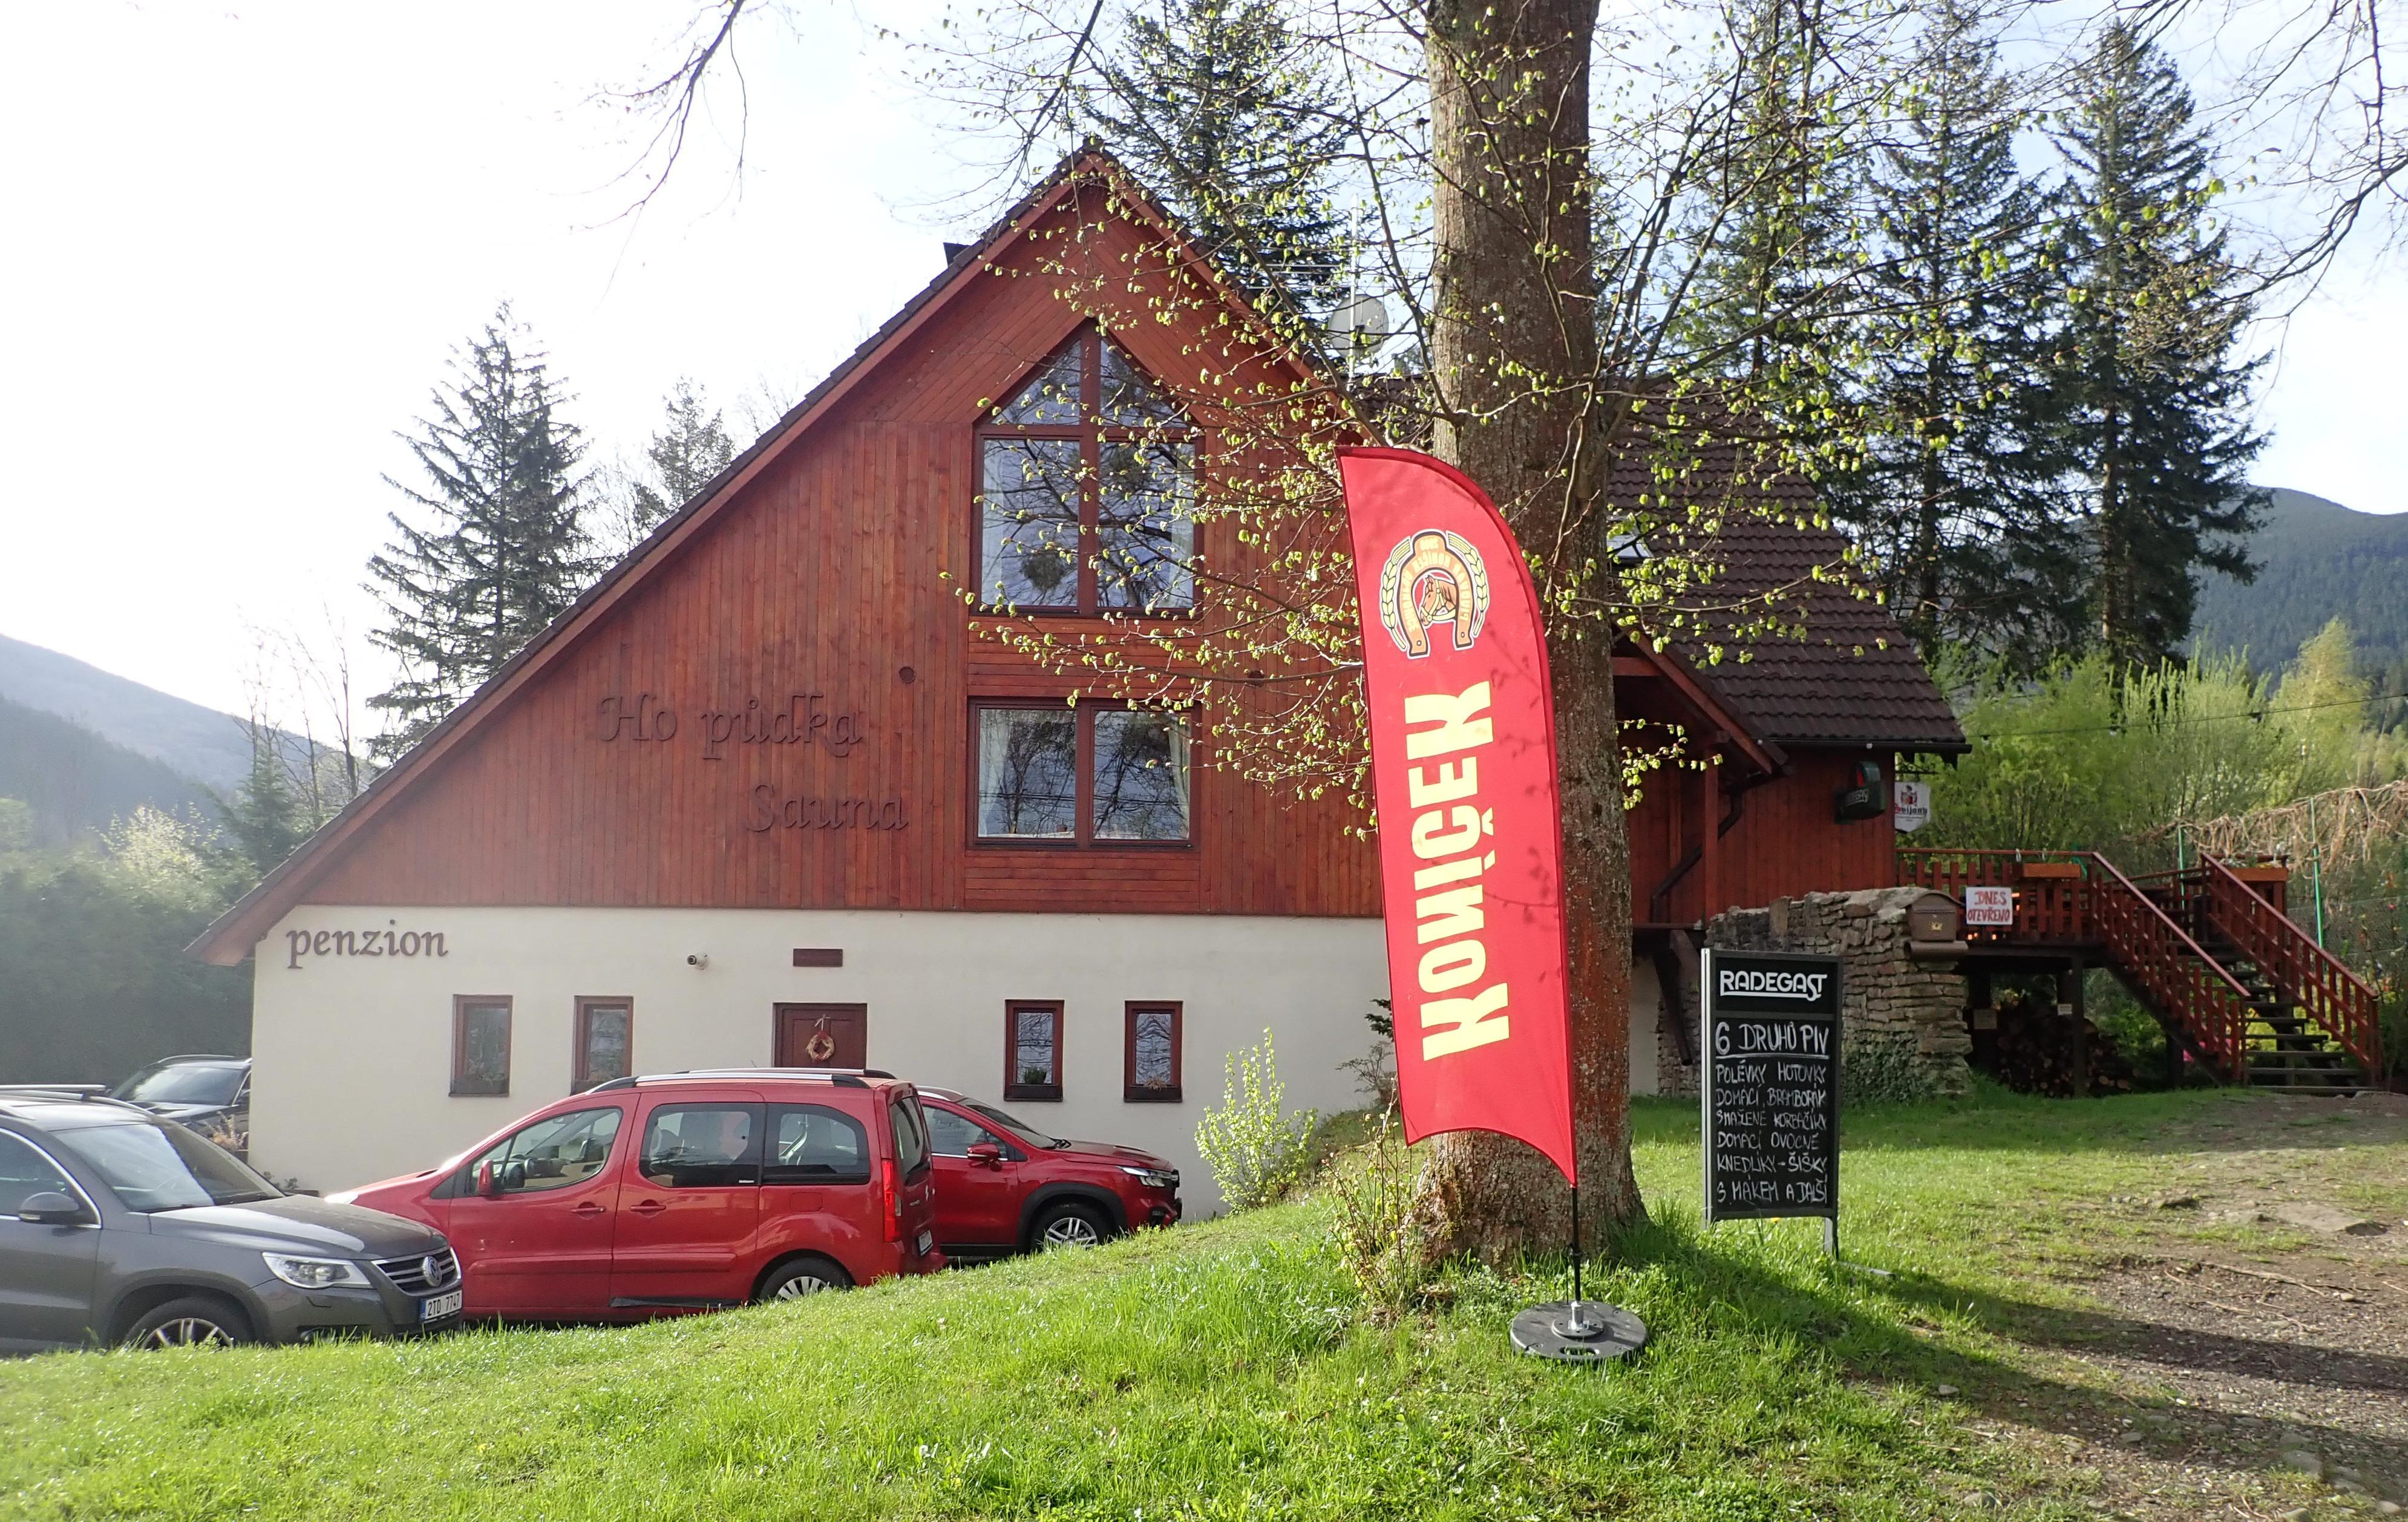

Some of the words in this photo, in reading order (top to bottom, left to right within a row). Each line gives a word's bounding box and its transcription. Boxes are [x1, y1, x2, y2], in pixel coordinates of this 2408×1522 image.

[745, 784, 909, 832] Sauna
[1974, 890, 2007, 906] DNES
[1968, 906, 2010, 922] OTEVŘENO
[286, 919, 448, 969] penzion
[1720, 970, 1827, 1001] RADEGAST
[1716, 1022, 1730, 1055] 6
[1738, 1021, 1796, 1050] DRUHŮ
[1800, 1025, 1829, 1054] PIV
[1716, 1059, 1767, 1084] POLÉVKY
[1778, 1061, 1827, 1084] HOTOVKY
[1716, 1084, 1762, 1107] DOMÁCÍ
[1767, 1083, 1827, 1108] BRAMBORÁK
[1717, 1130, 1761, 1150] DOMÁCÍ
[1771, 1132, 1819, 1149] OVOCNÉ
[1732, 1174, 1779, 1202] MÁKEM
[1786, 1183, 1795, 1201] A
[1796, 1174, 1827, 1203] DALŠÍ
[428, 1300, 441, 1316] 2TD
[447, 1293, 460, 1311] 7747
